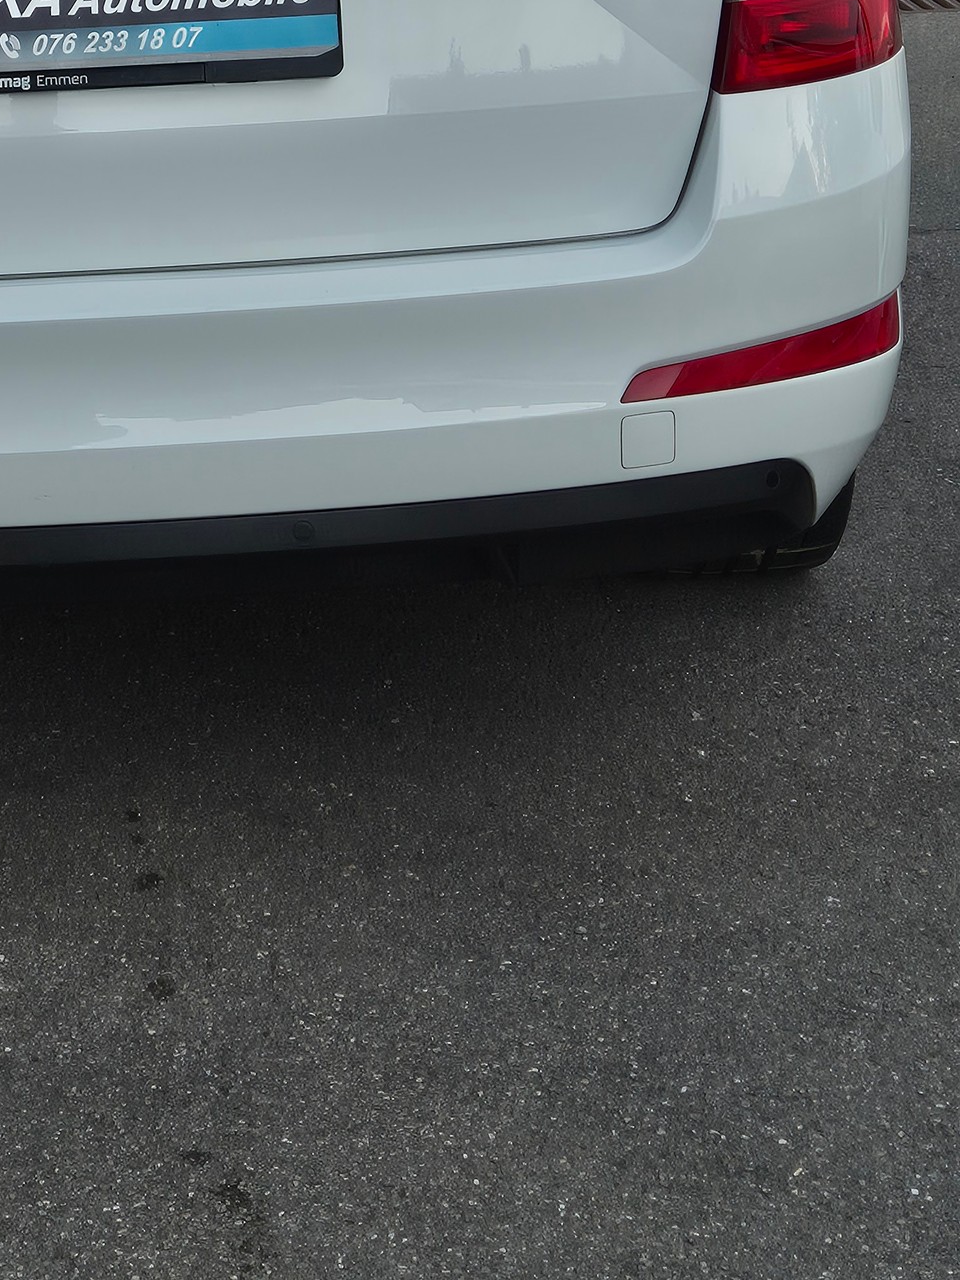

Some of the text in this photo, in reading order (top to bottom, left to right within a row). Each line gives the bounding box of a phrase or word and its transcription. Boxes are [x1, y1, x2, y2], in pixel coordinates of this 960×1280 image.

[32, 26, 203, 57] 076 233 18 07
[36, 73, 89, 88] Emmen
